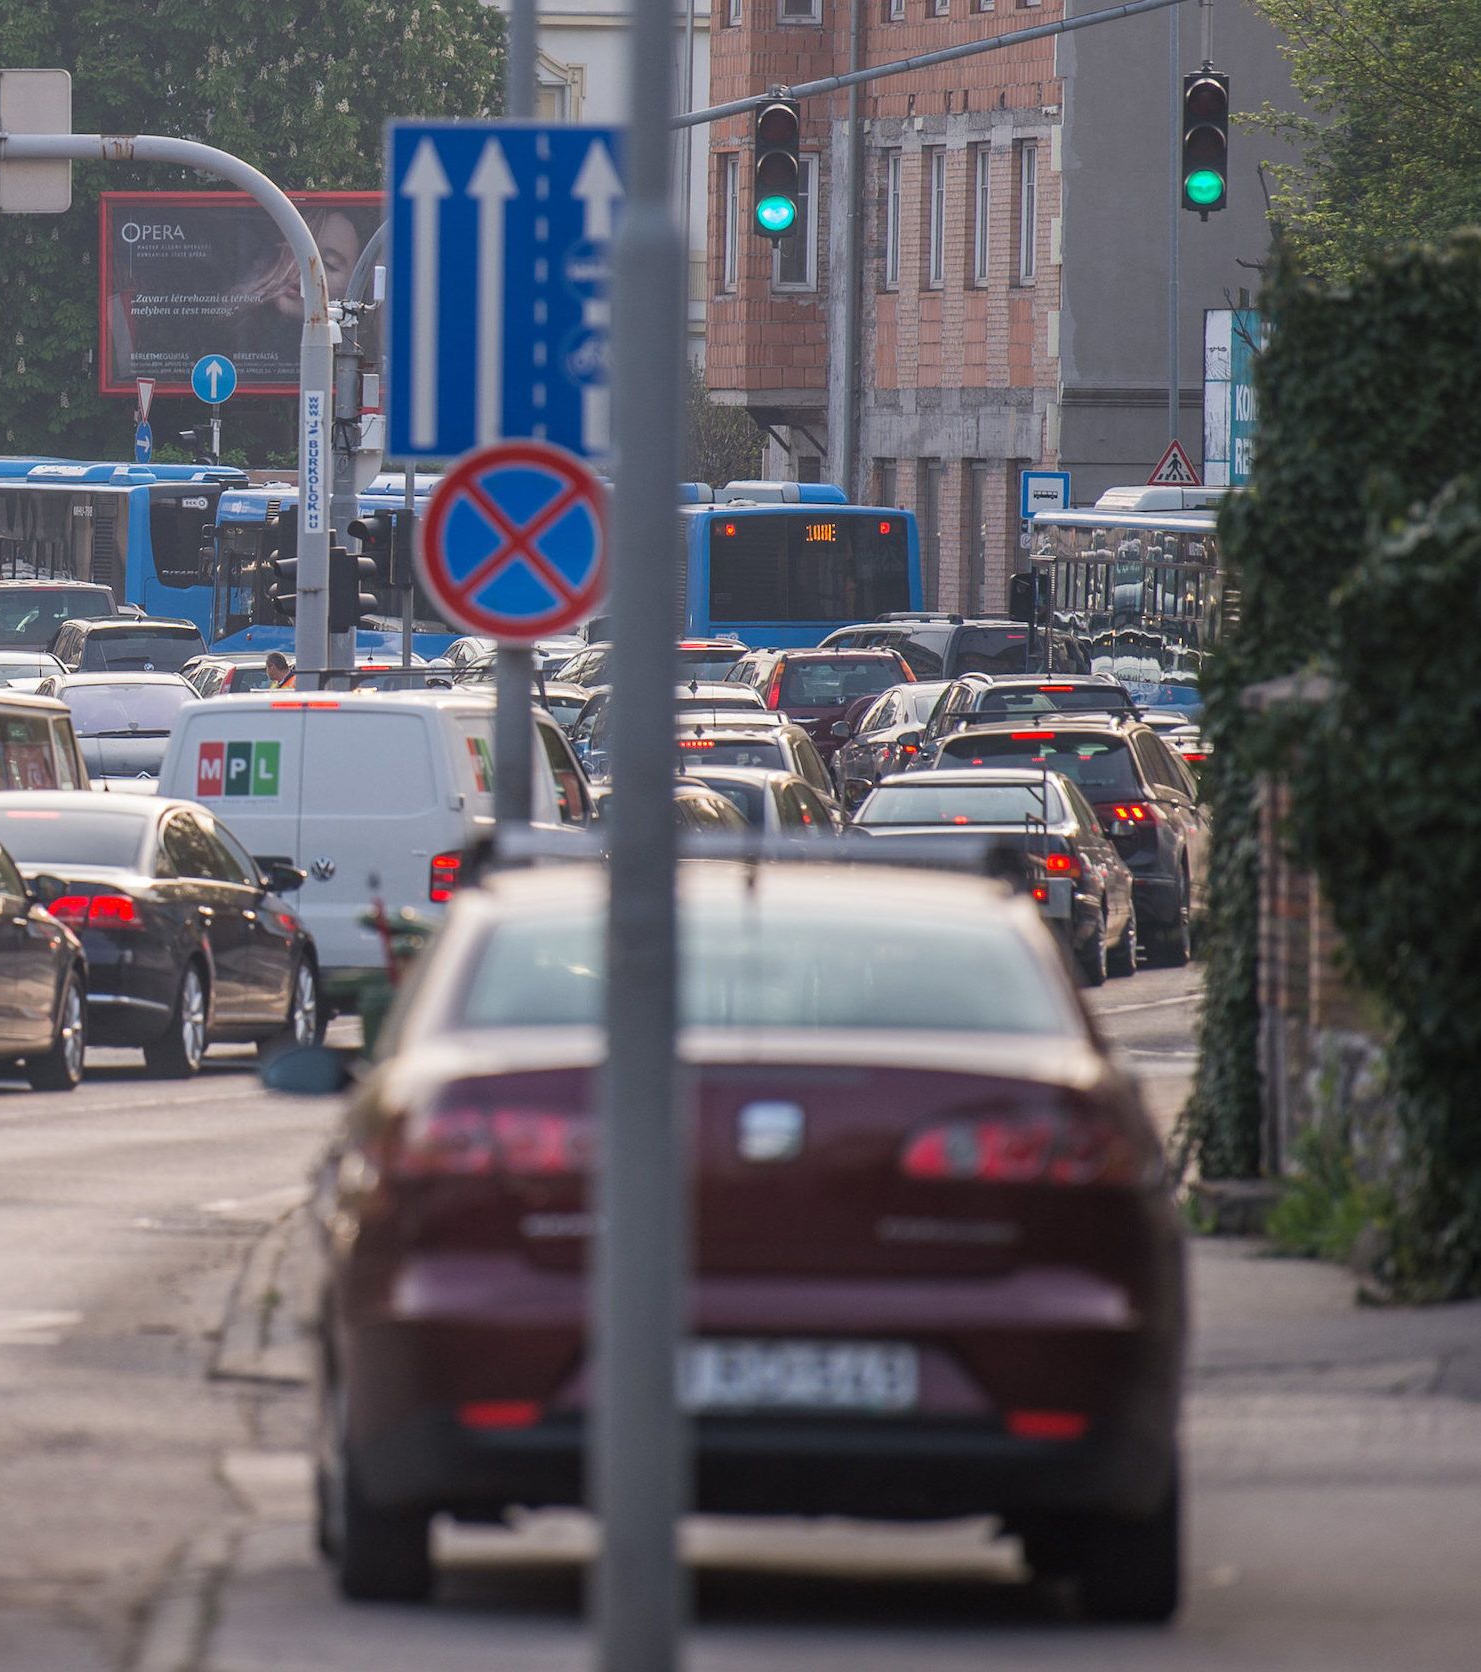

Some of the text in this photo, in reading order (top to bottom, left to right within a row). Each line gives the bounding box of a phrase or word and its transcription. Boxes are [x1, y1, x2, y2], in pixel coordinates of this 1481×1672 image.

[121, 222, 185, 243] OPERA
[170, 293, 220, 303] létrehozni
[130, 306, 171, 316] melyben
[182, 307, 199, 315] test
[200, 758, 273, 780] MPL
